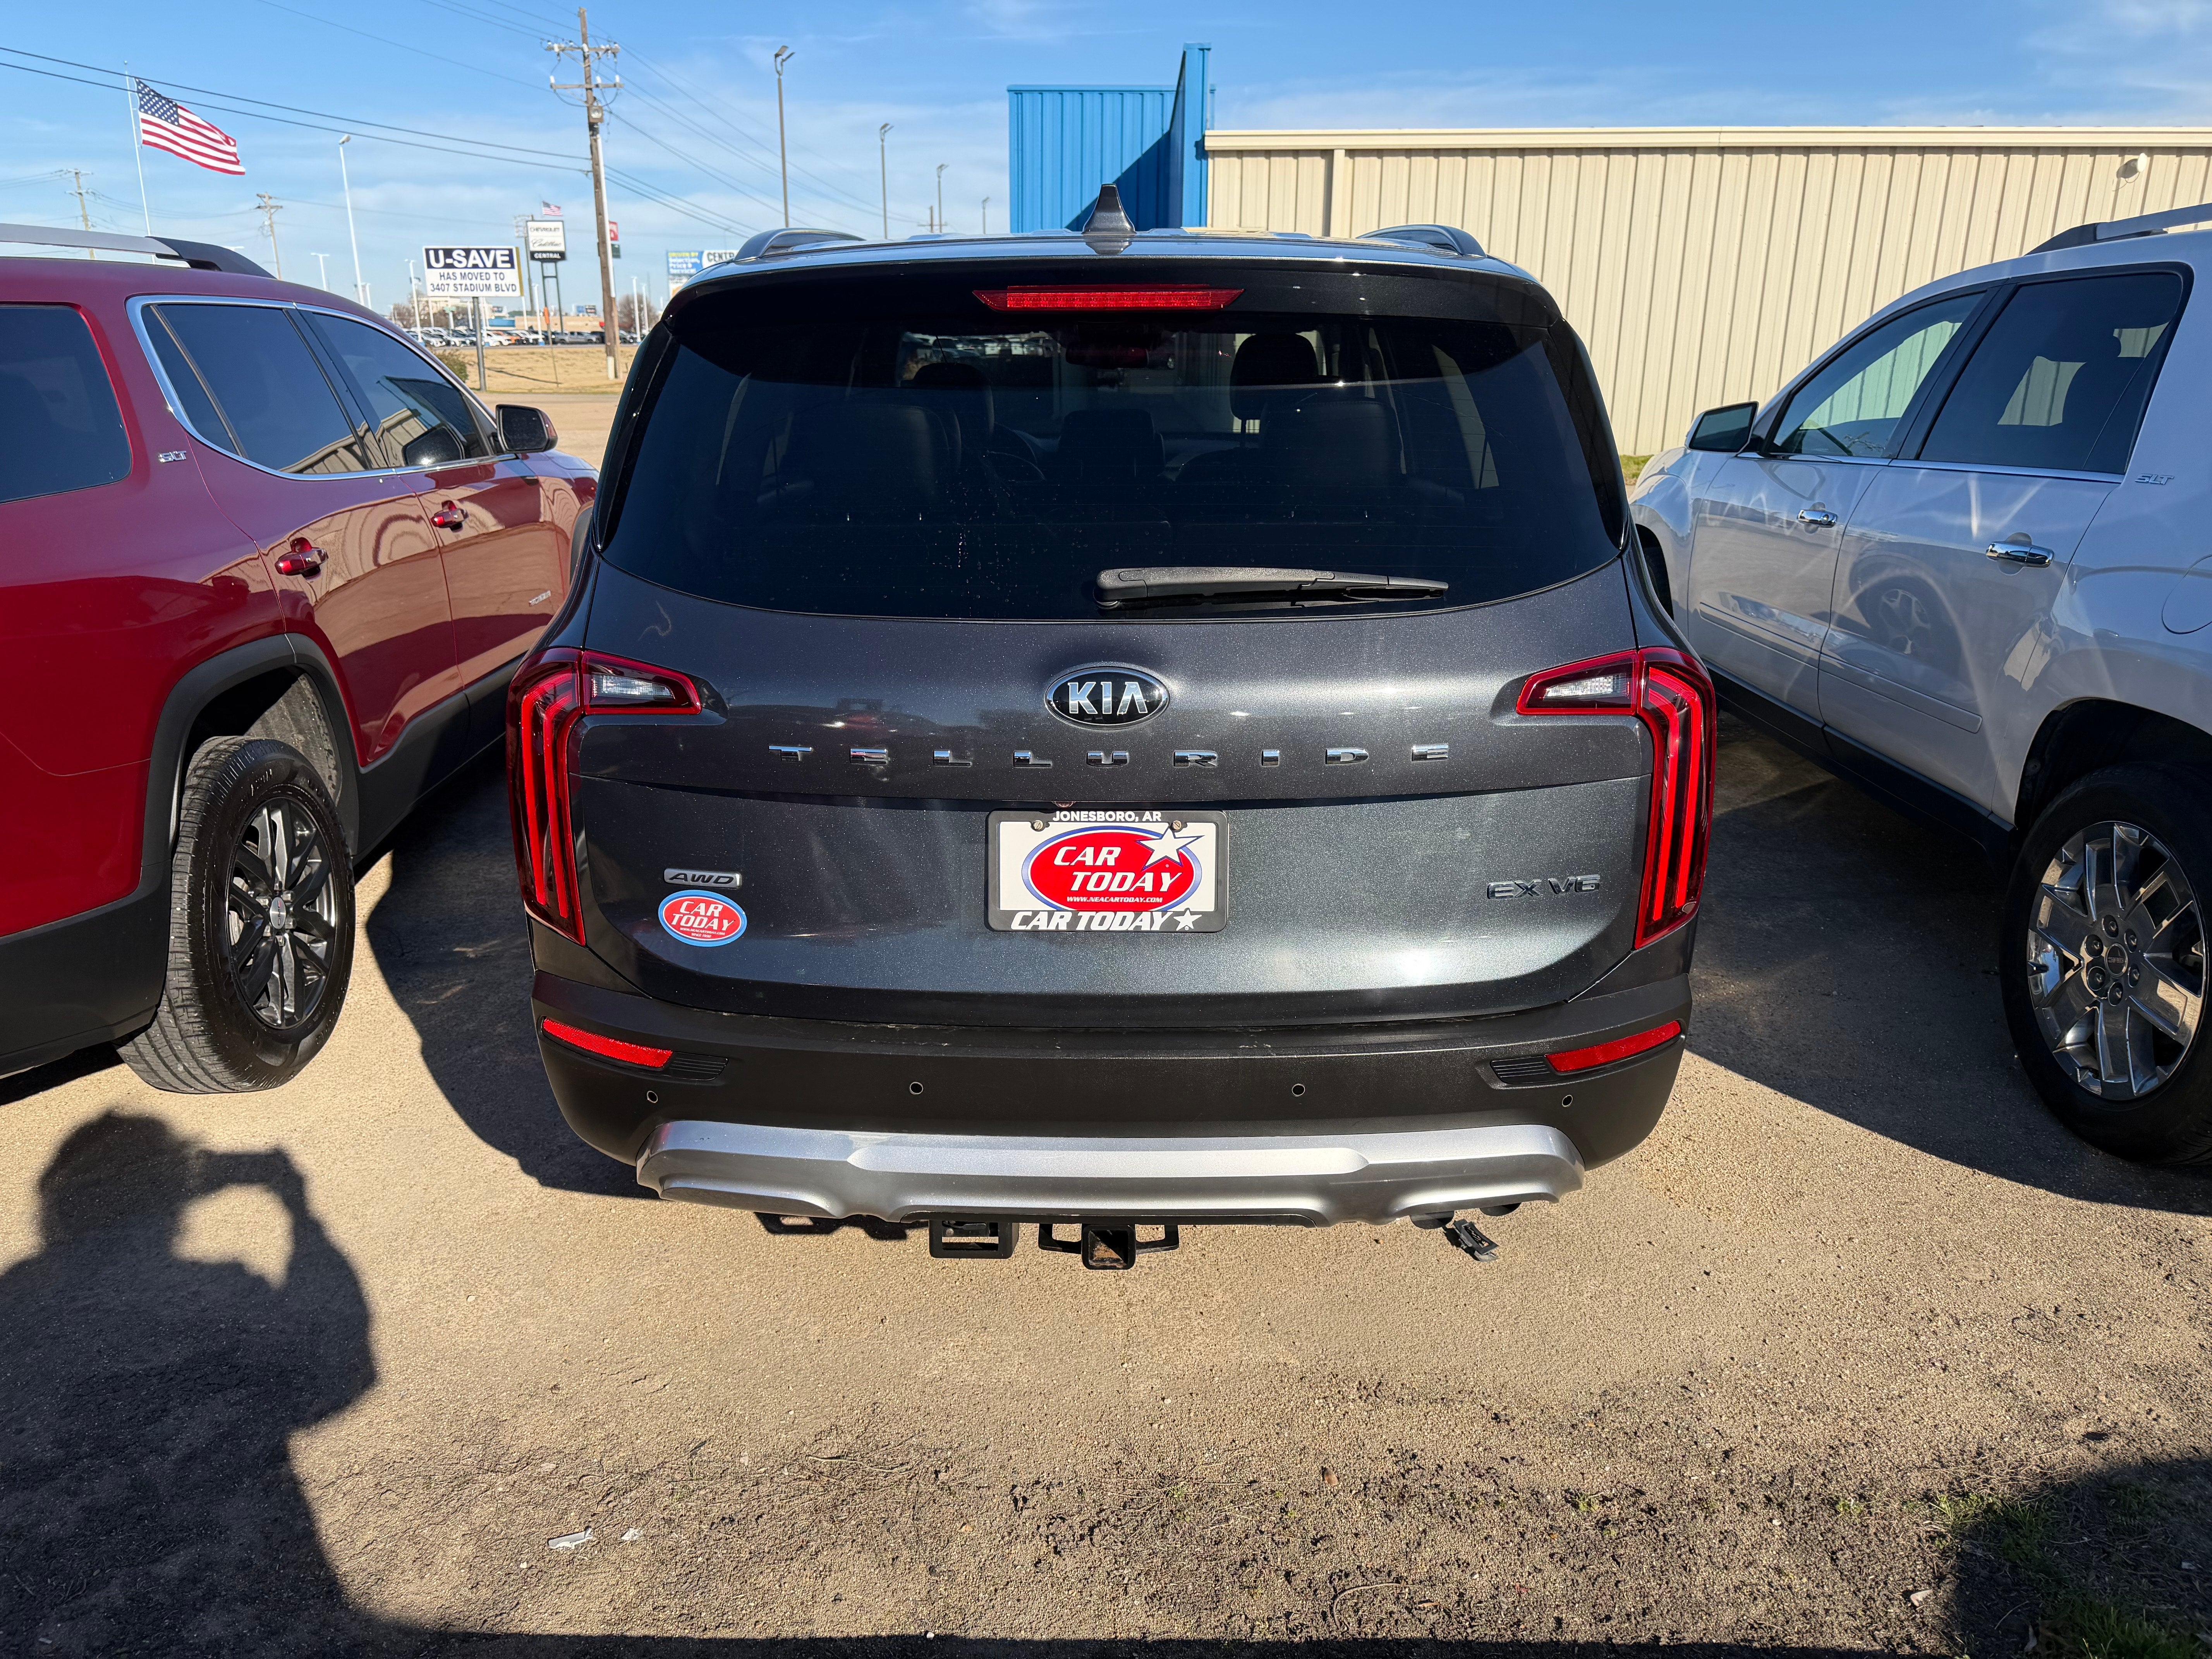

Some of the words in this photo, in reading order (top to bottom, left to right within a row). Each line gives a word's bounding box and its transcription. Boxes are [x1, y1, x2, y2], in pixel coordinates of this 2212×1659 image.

[429, 249, 511, 268] U-SAVE
[439, 272, 457, 280] HAS
[460, 272, 491, 280] MOVED
[493, 272, 505, 280] TO
[430, 283, 450, 292] 3407
[453, 283, 492, 292] STADIUM
[495, 283, 517, 292] BLVD
[2135, 473, 2175, 485] SLT
[1067, 682, 1148, 715] KIA
[769, 744, 1449, 768] TELLURIDE
[1053, 811, 1139, 823] JONESBORO,
[1143, 811, 1162, 821] AR
[1054, 846, 1121, 866] CAR
[668, 872, 734, 884] AWD
[1070, 871, 1182, 892] TODAY
[1487, 879, 1542, 900] EX
[1548, 874, 1601, 895] V6
[680, 901, 724, 917] CAR
[671, 913, 735, 931] TODAY
[1011, 911, 1072, 930] CAR
[1076, 911, 1173, 931] TODAY
